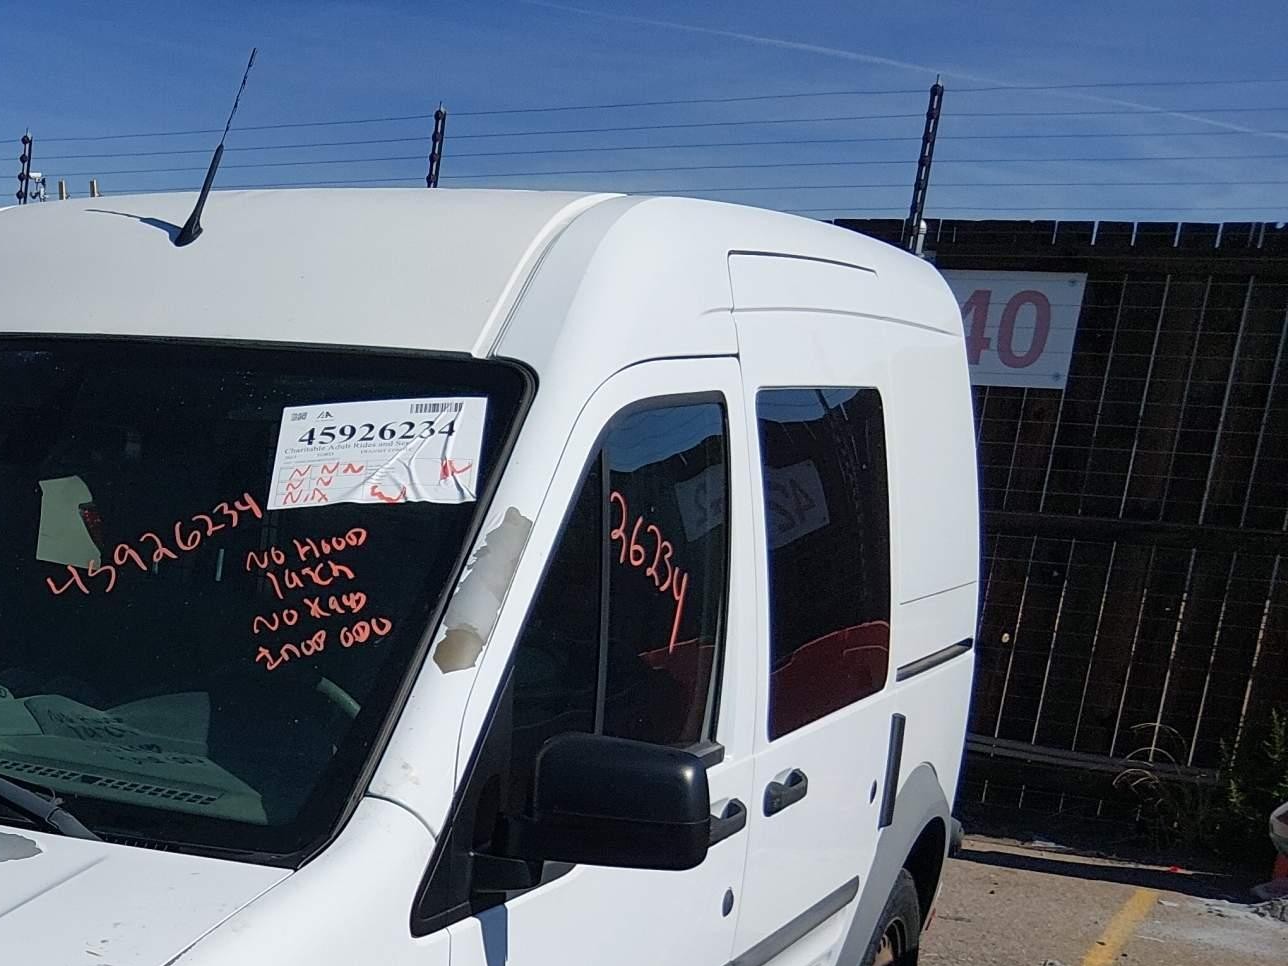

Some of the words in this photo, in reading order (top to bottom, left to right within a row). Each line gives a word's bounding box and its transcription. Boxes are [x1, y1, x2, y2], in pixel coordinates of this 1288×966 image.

[962, 289, 1051, 369] 40
[297, 420, 456, 446] 45926234
[46, 492, 262, 594] 45926234
[610, 491, 688, 655] 26234
